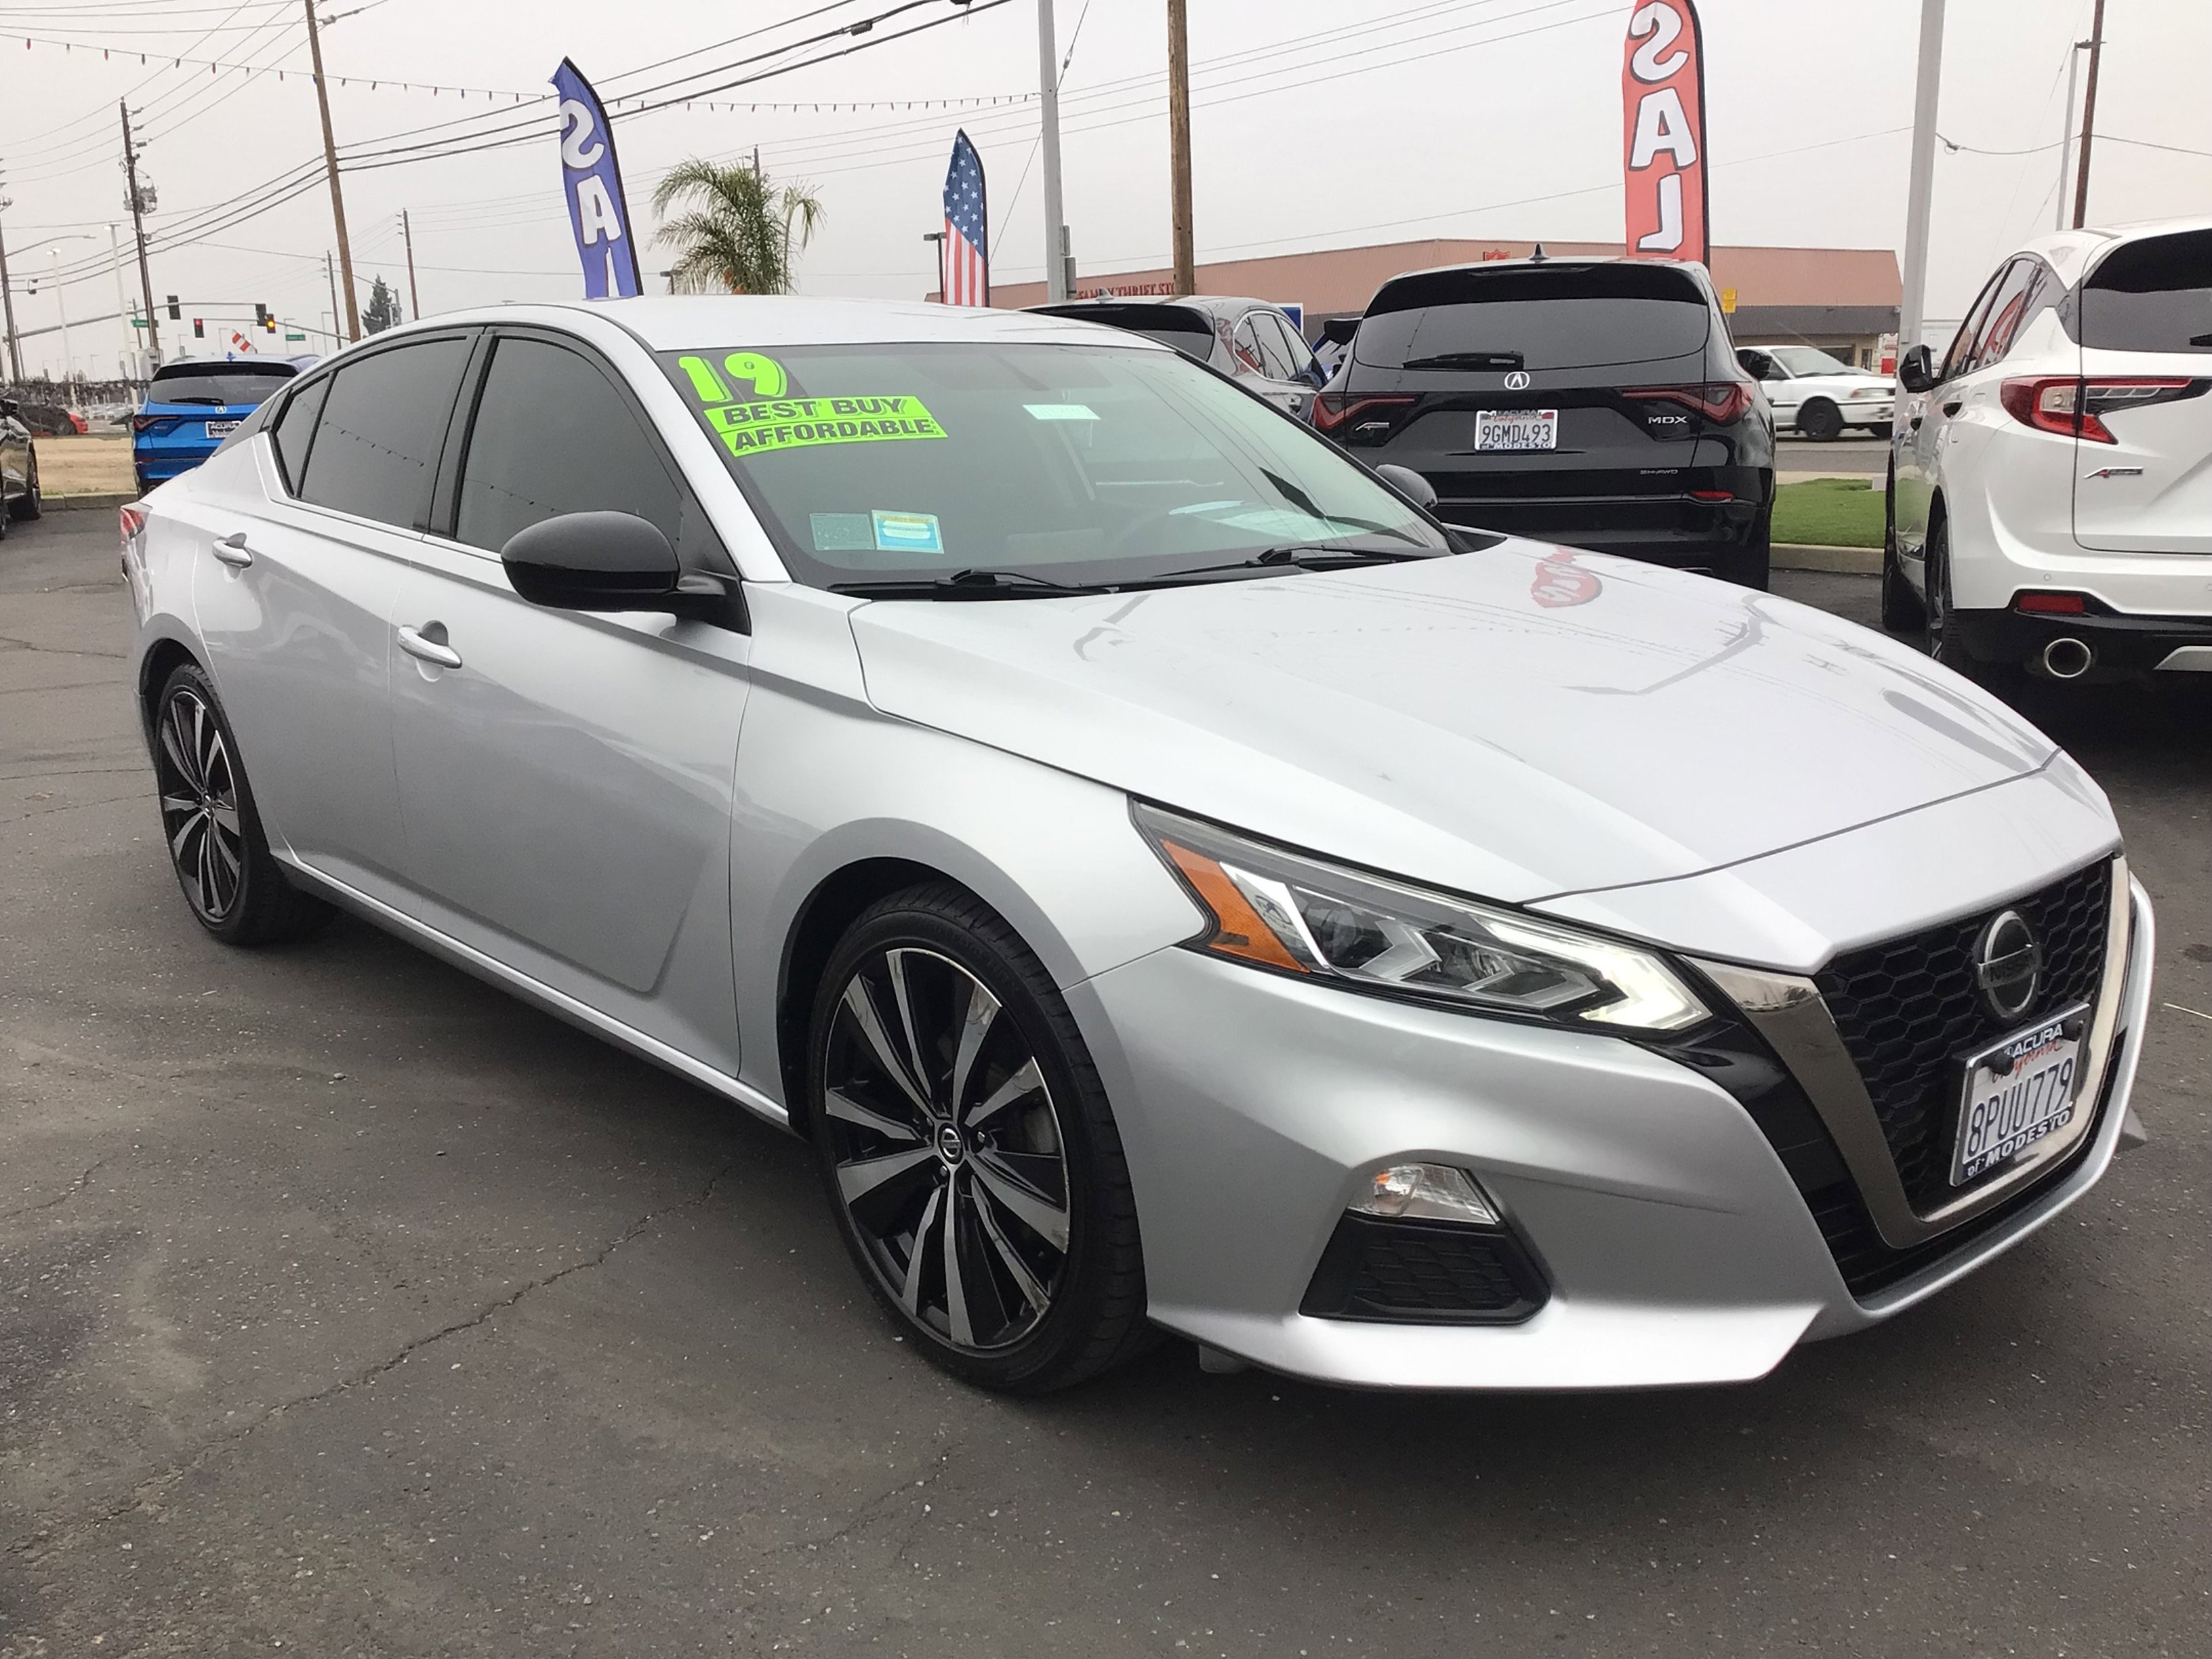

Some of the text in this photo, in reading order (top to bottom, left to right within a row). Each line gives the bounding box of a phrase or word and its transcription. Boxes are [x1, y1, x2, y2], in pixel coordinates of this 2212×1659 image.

[1076, 286, 1115, 299] FAMY
[1116, 283, 1156, 296] THRIFT
[678, 352, 787, 402] 19
[723, 398, 907, 427] BEST BUY
[1648, 416, 1687, 424] MDX
[735, 418, 937, 451] AFFORDABLE
[1482, 424, 1551, 443] 9GMD493
[2013, 1023, 2063, 1057] ACURA
[1967, 1057, 2073, 1157] 8PUU779
[1985, 1109, 2070, 1167] MODESTO
